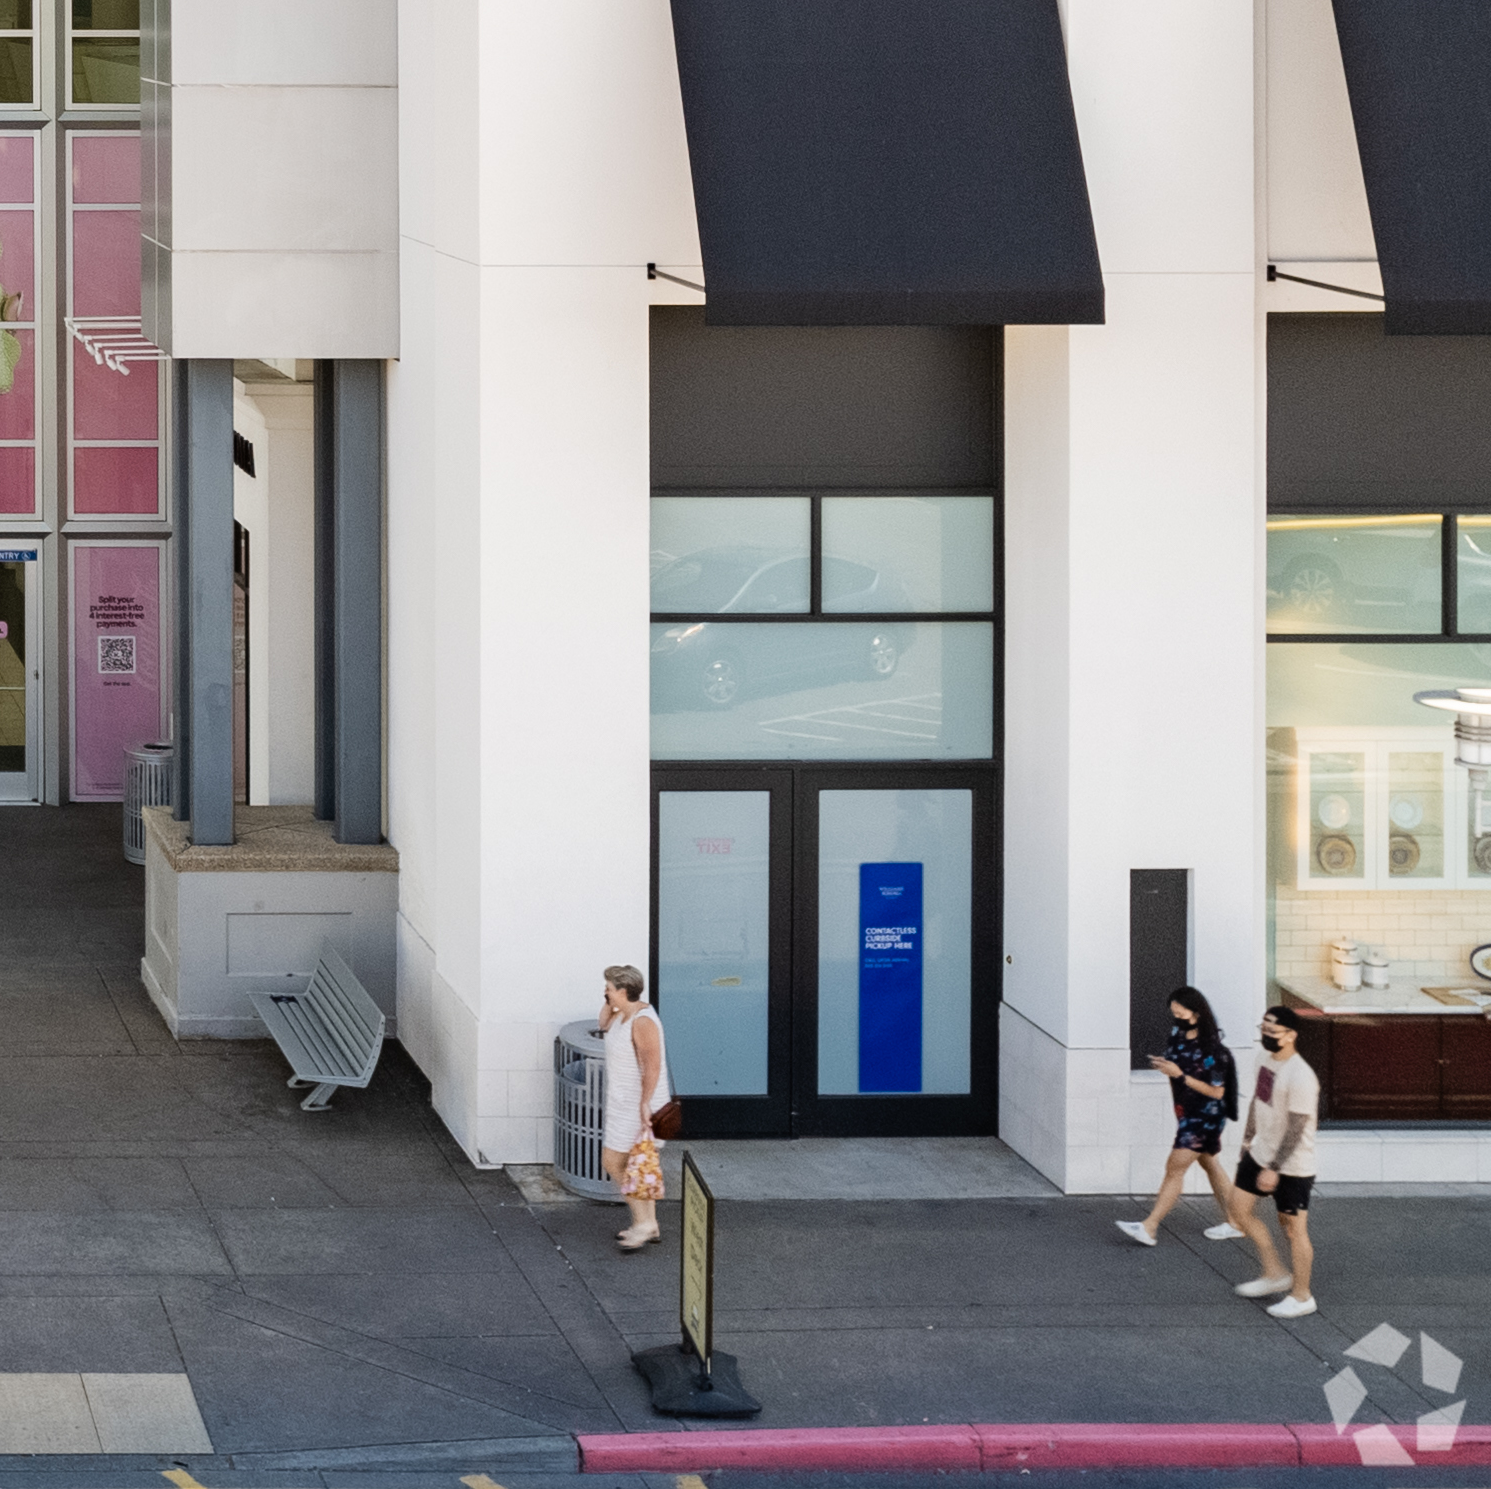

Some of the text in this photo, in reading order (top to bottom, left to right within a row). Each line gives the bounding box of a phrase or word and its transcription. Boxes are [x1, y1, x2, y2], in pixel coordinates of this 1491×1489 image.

[98, 595, 135, 605] Split your
[90, 604, 143, 612] purchase into
[96, 612, 145, 620] interest-free
[96, 620, 137, 629] payments.
[865, 942, 912, 950] PICKUP HERE
